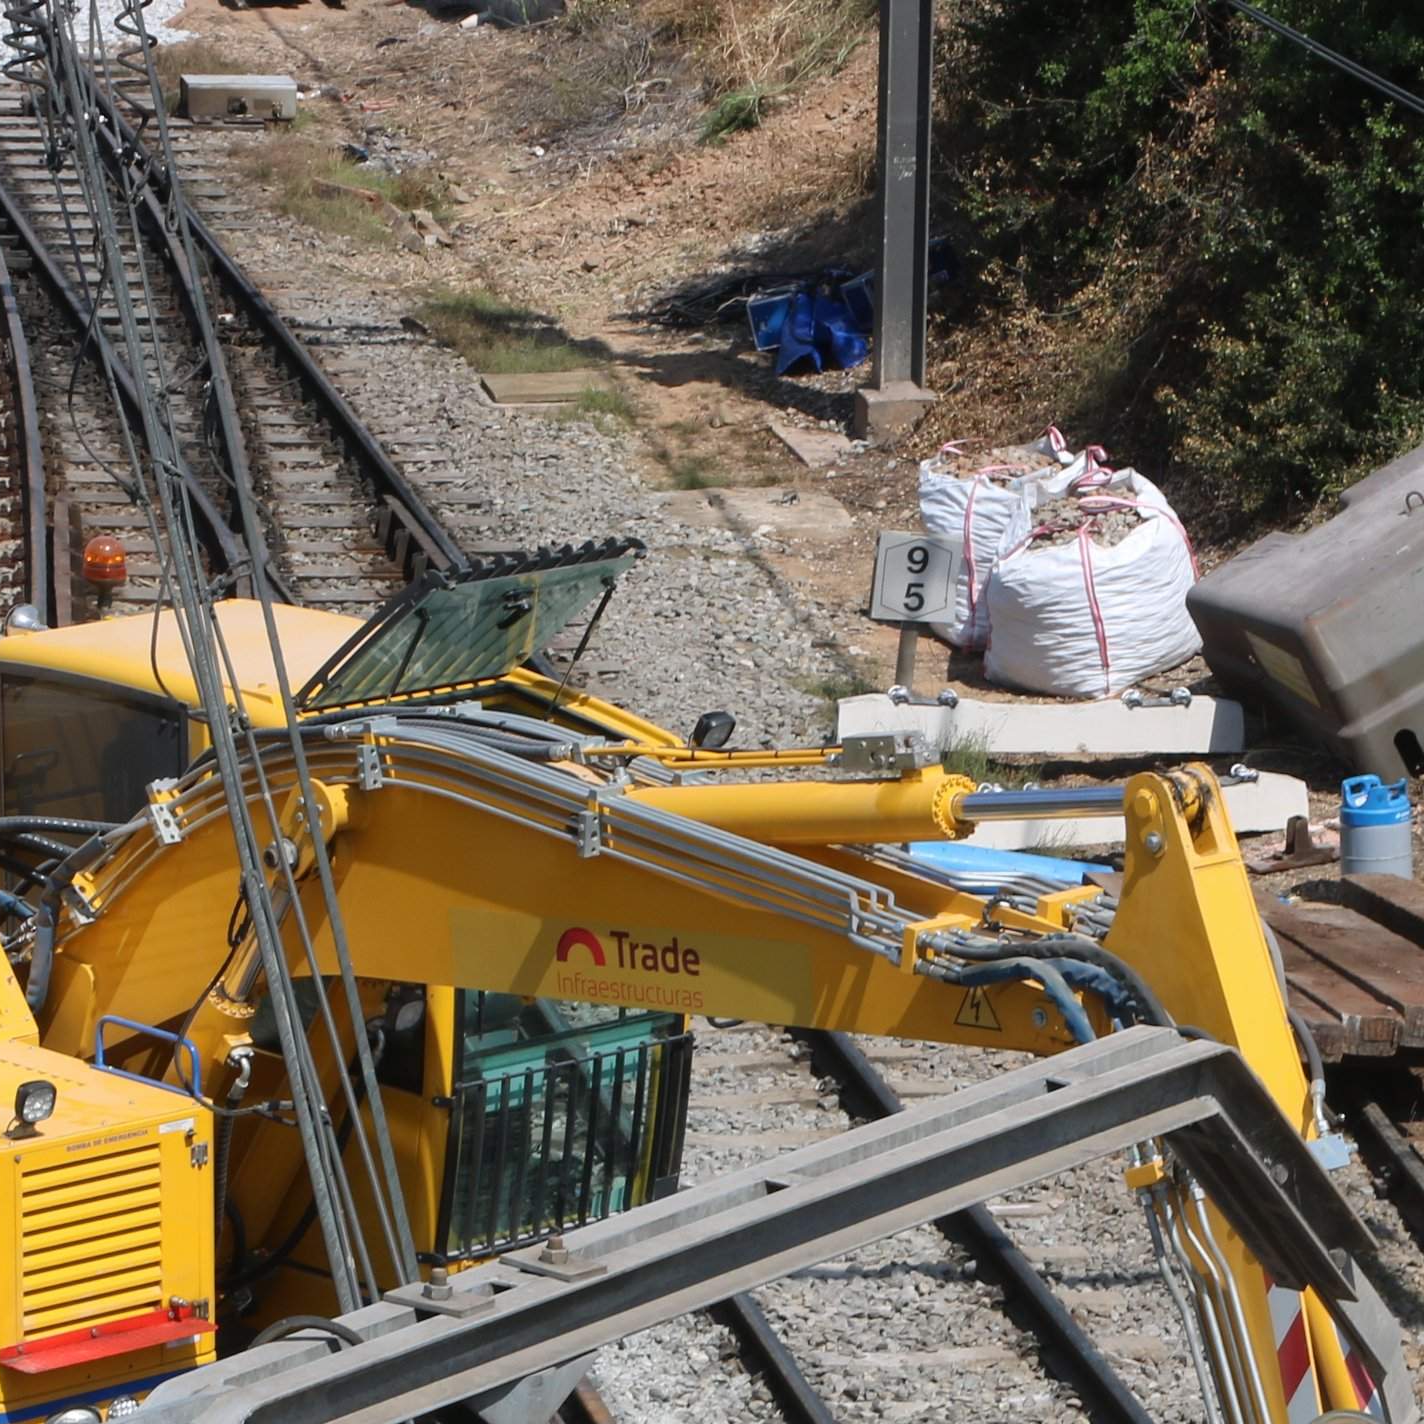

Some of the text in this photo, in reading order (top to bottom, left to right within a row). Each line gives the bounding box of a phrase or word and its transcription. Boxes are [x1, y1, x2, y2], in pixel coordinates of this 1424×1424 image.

[907, 546, 929, 574] 9
[904, 583, 925, 612] 5
[609, 929, 701, 976] Trade
[555, 972, 704, 1009] Infraestructuras
